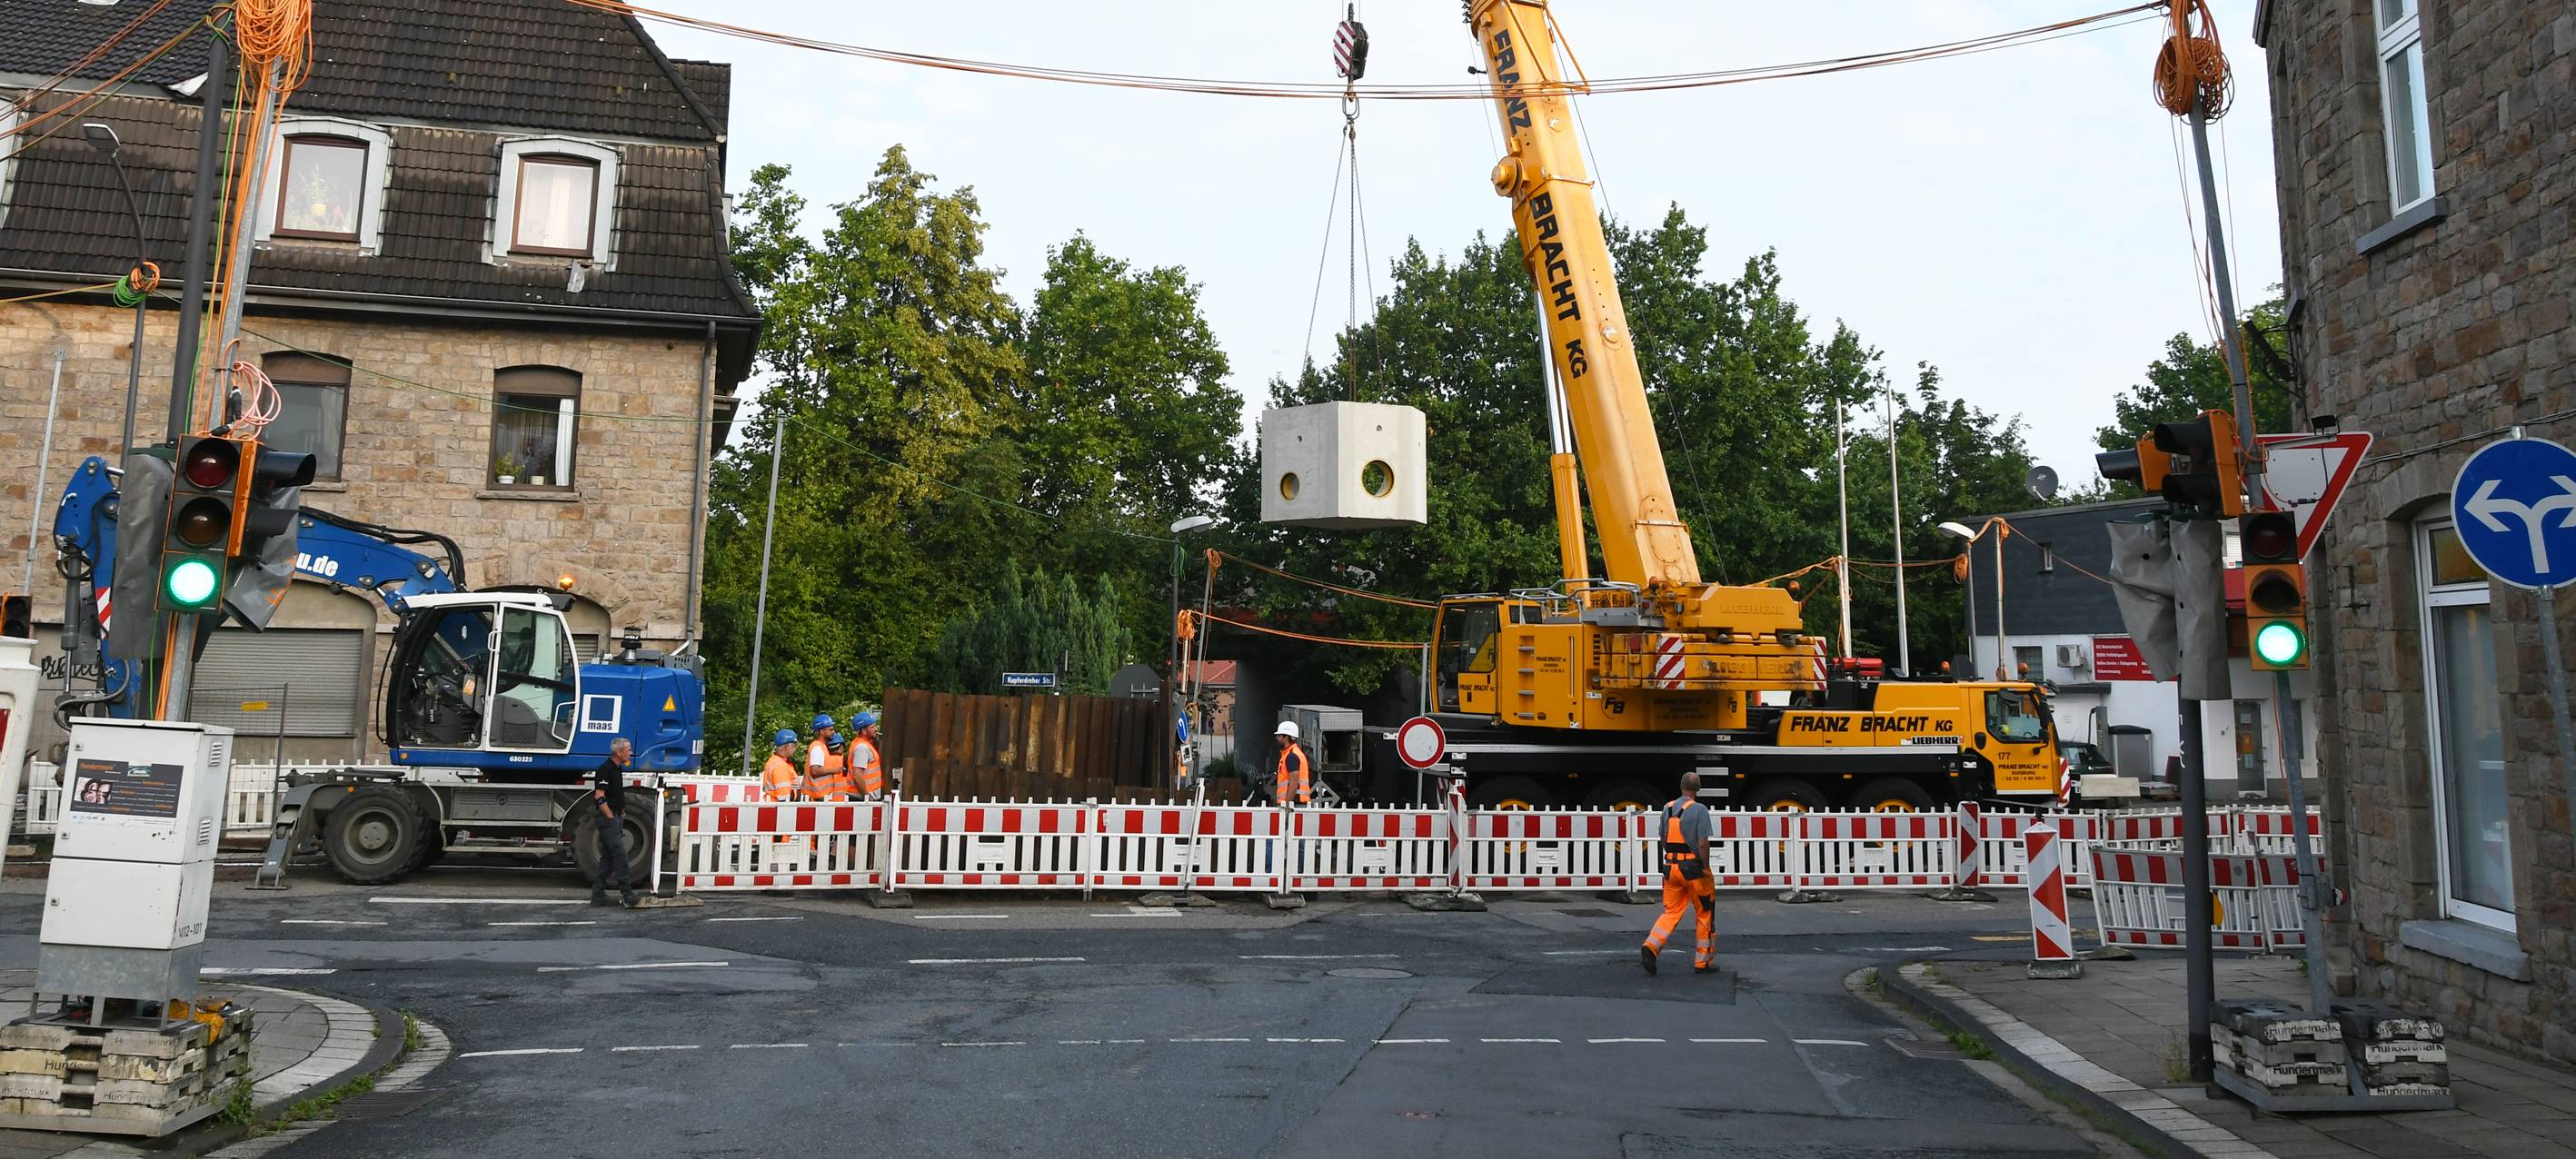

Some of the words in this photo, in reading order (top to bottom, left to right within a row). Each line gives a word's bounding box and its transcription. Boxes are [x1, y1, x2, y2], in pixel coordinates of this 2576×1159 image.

[1494, 29, 1532, 135] FRANZ
[1531, 191, 1581, 322] BRACHT
[1565, 338, 1587, 379] KG
[296, 552, 339, 577] u.de
[1008, 676, 1040, 685] Kupferdreher
[587, 721, 613, 731] maas
[1790, 716, 1851, 732] FRANZ
[1860, 716, 1929, 732] BRACHT
[1934, 719, 1954, 732] KG
[1912, 737, 1959, 745] LIEBHERR
[1997, 752, 2011, 760] 177
[2269, 1022, 2340, 1035] Hundertmark
[2273, 1065, 2343, 1075] Hundertmark
[2377, 1086, 2449, 1096] Hundertmark
